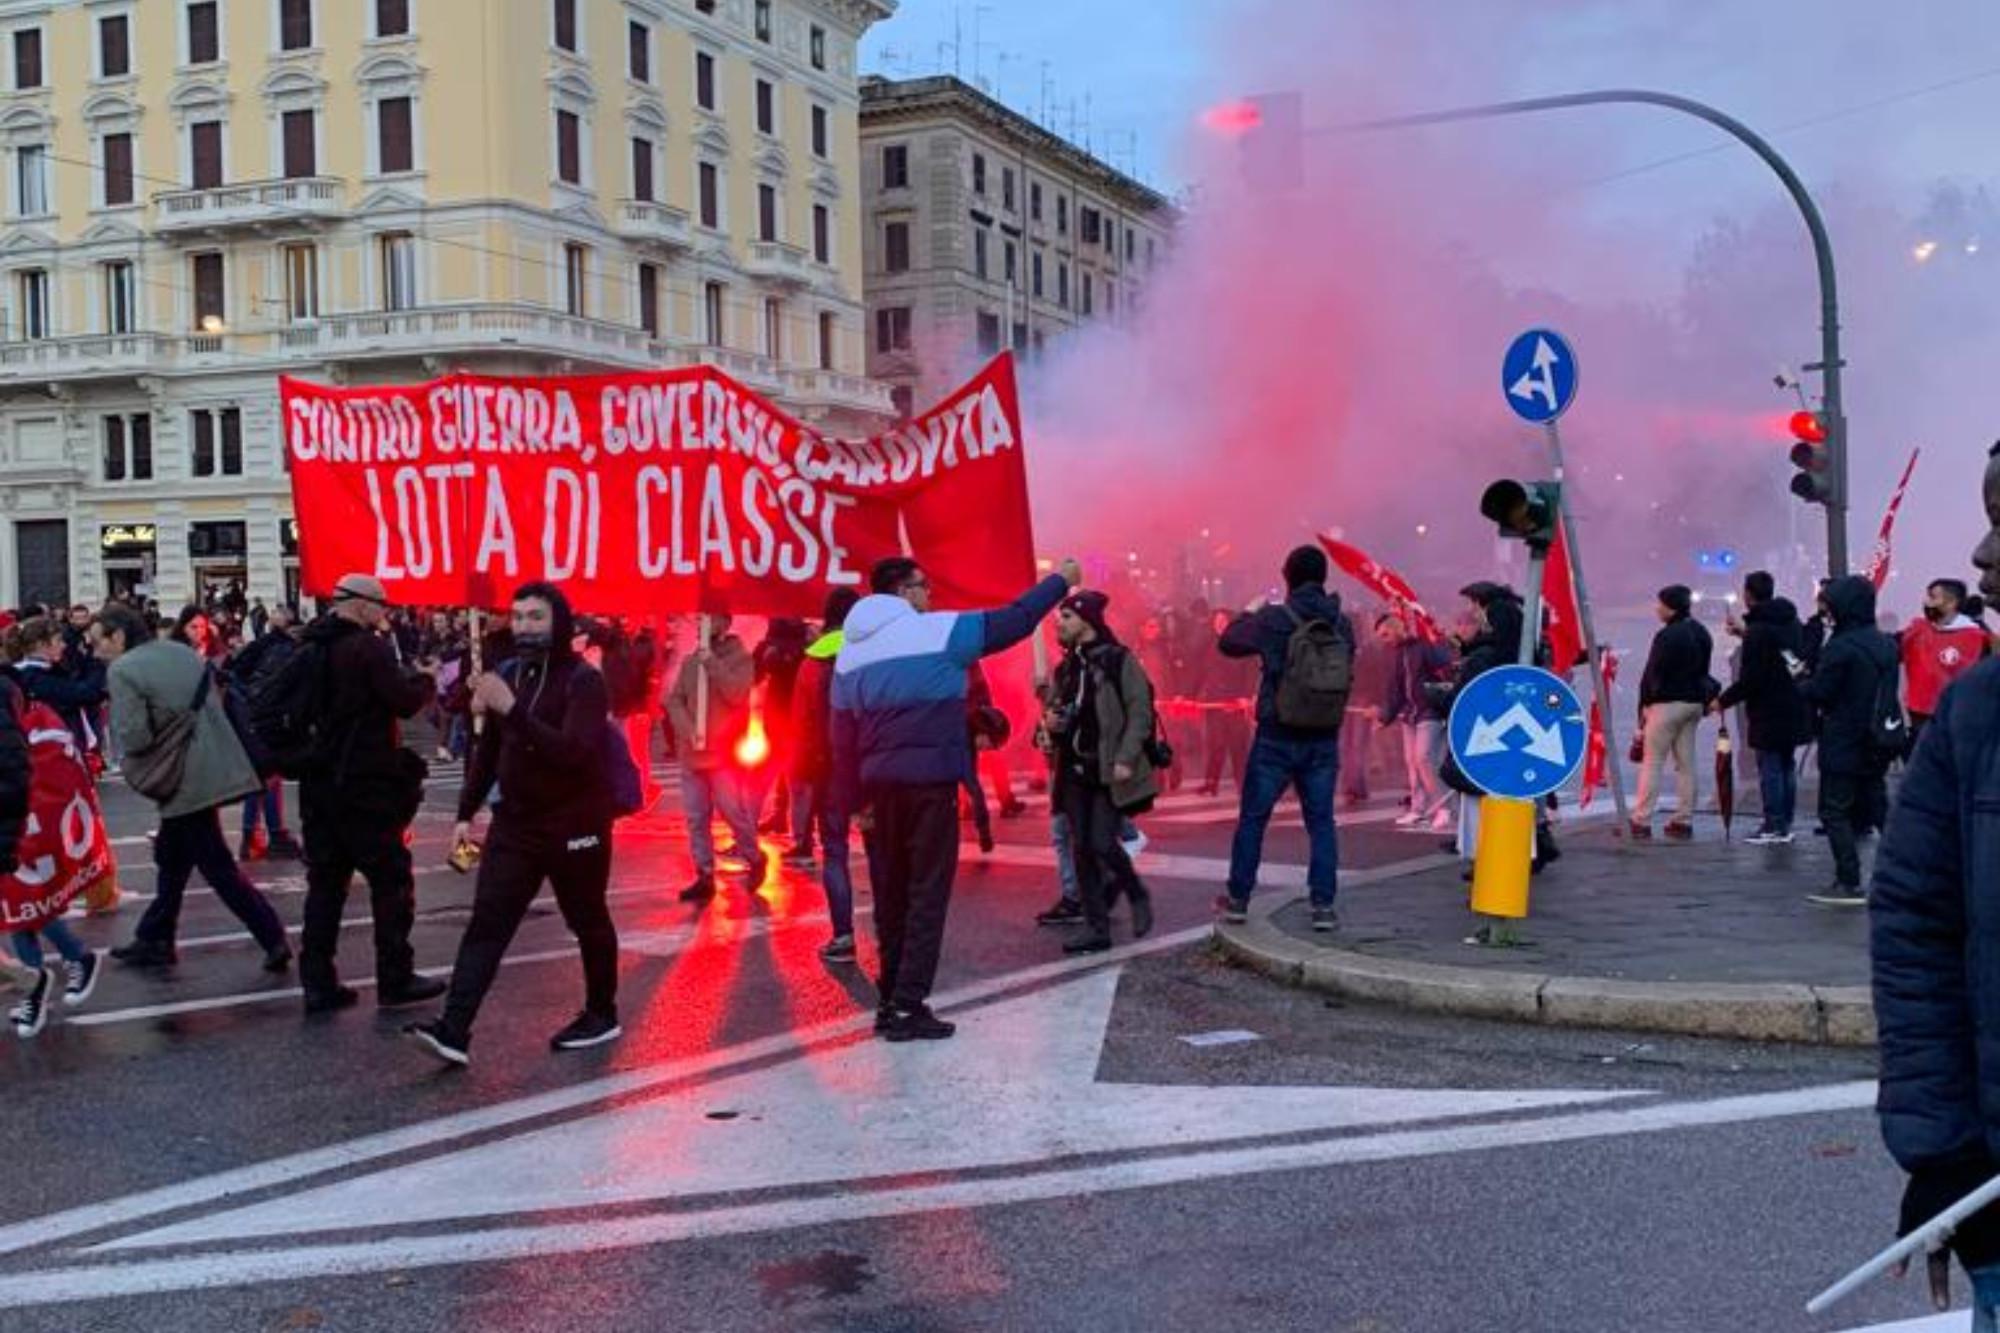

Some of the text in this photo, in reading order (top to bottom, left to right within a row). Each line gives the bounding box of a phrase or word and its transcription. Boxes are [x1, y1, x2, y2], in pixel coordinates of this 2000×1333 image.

[289, 395, 422, 462] CONTRO
[430, 384, 597, 463] GUERRA,
[795, 383, 1014, 486] CAROVITA
[364, 463, 862, 585] LOTTA DI CLASSE
